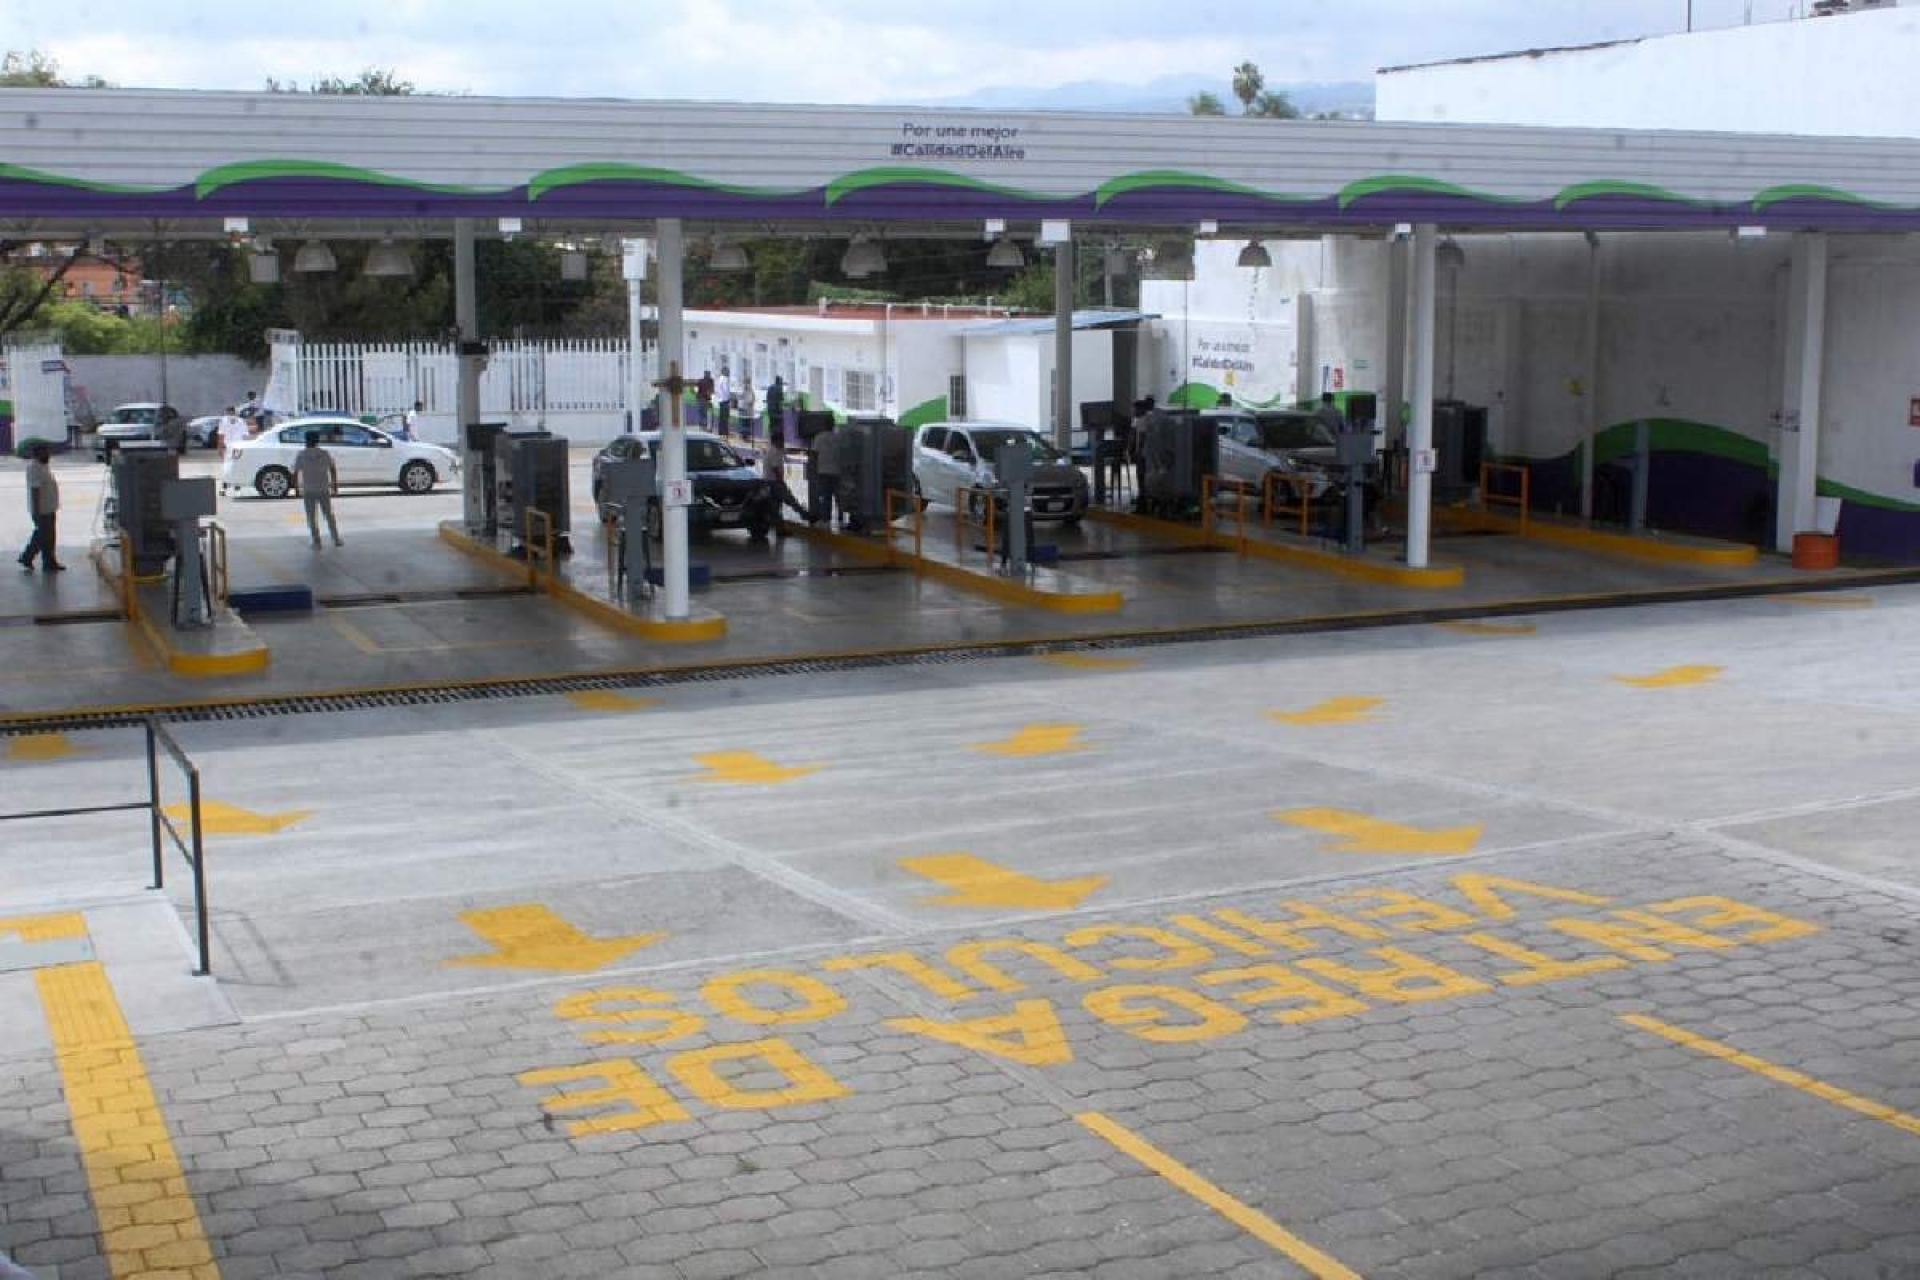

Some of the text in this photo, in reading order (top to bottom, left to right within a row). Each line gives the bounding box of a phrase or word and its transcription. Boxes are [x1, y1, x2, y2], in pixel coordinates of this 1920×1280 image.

[903, 123, 930, 137] Por
[971, 126, 1019, 143] mejor
[518, 895, 1820, 1138] ENTREGA DE
[555, 873, 1610, 1045] VEHICULOS
